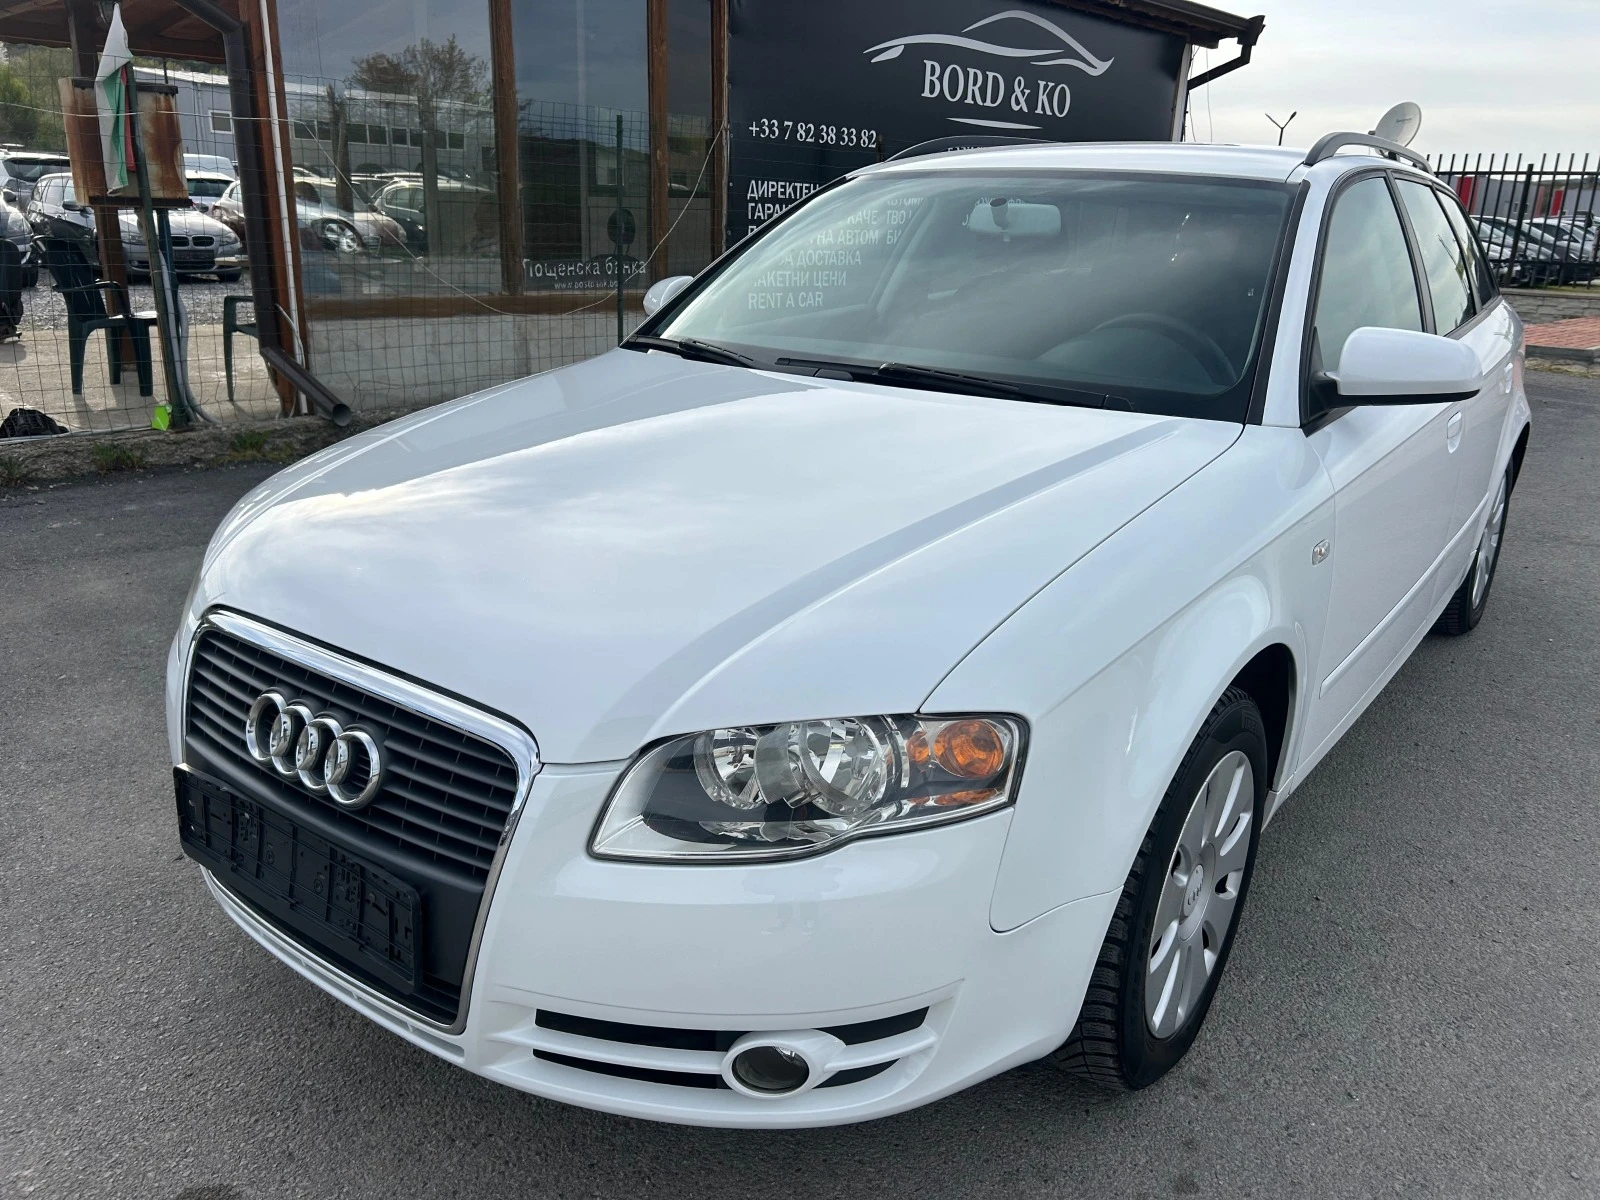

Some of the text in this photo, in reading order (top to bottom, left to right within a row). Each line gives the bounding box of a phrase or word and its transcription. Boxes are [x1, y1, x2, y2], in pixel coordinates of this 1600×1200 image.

[921, 60, 1071, 118] BORD & KO
[749, 118, 877, 148] +33 7 82 38 33 82
[796, 249, 861, 268] ДОСТАВКА
[754, 271, 847, 289] АКЕТНИ ЦЕНИ
[748, 291, 824, 310] RENT A CAR
